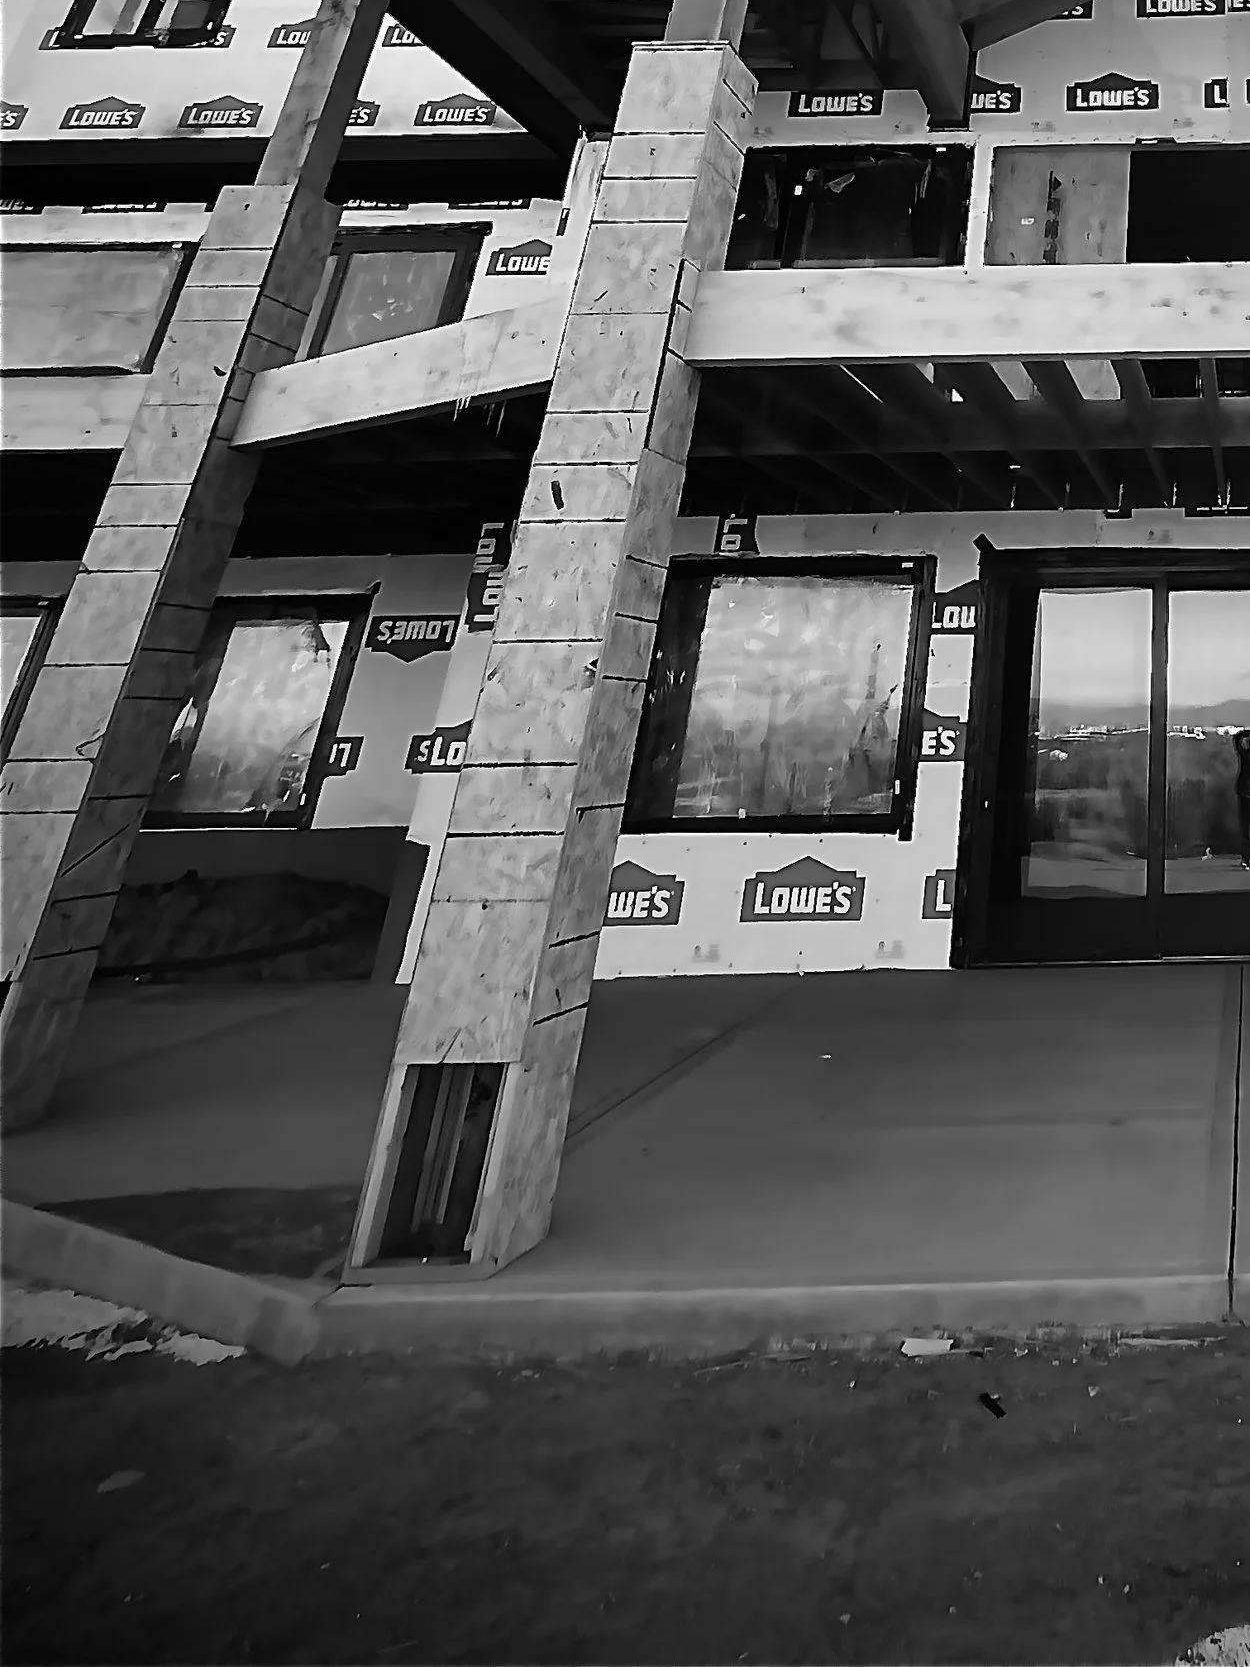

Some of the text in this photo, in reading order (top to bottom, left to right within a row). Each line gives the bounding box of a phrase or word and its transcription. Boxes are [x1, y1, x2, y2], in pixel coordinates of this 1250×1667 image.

[798, 92, 874, 113] LOWE'S
[1076, 87, 1150, 107] LOWE'S
[69, 109, 138, 126] LOWE'S
[187, 107, 255, 125] LOWE'S
[422, 106, 491, 123] LOWE'S
[495, 253, 551, 272] LOWE
[377, 620, 456, 644] LOWE'S
[921, 726, 957, 756] E'S
[606, 885, 672, 918] WE'S
[754, 881, 853, 915] LOWE'S
